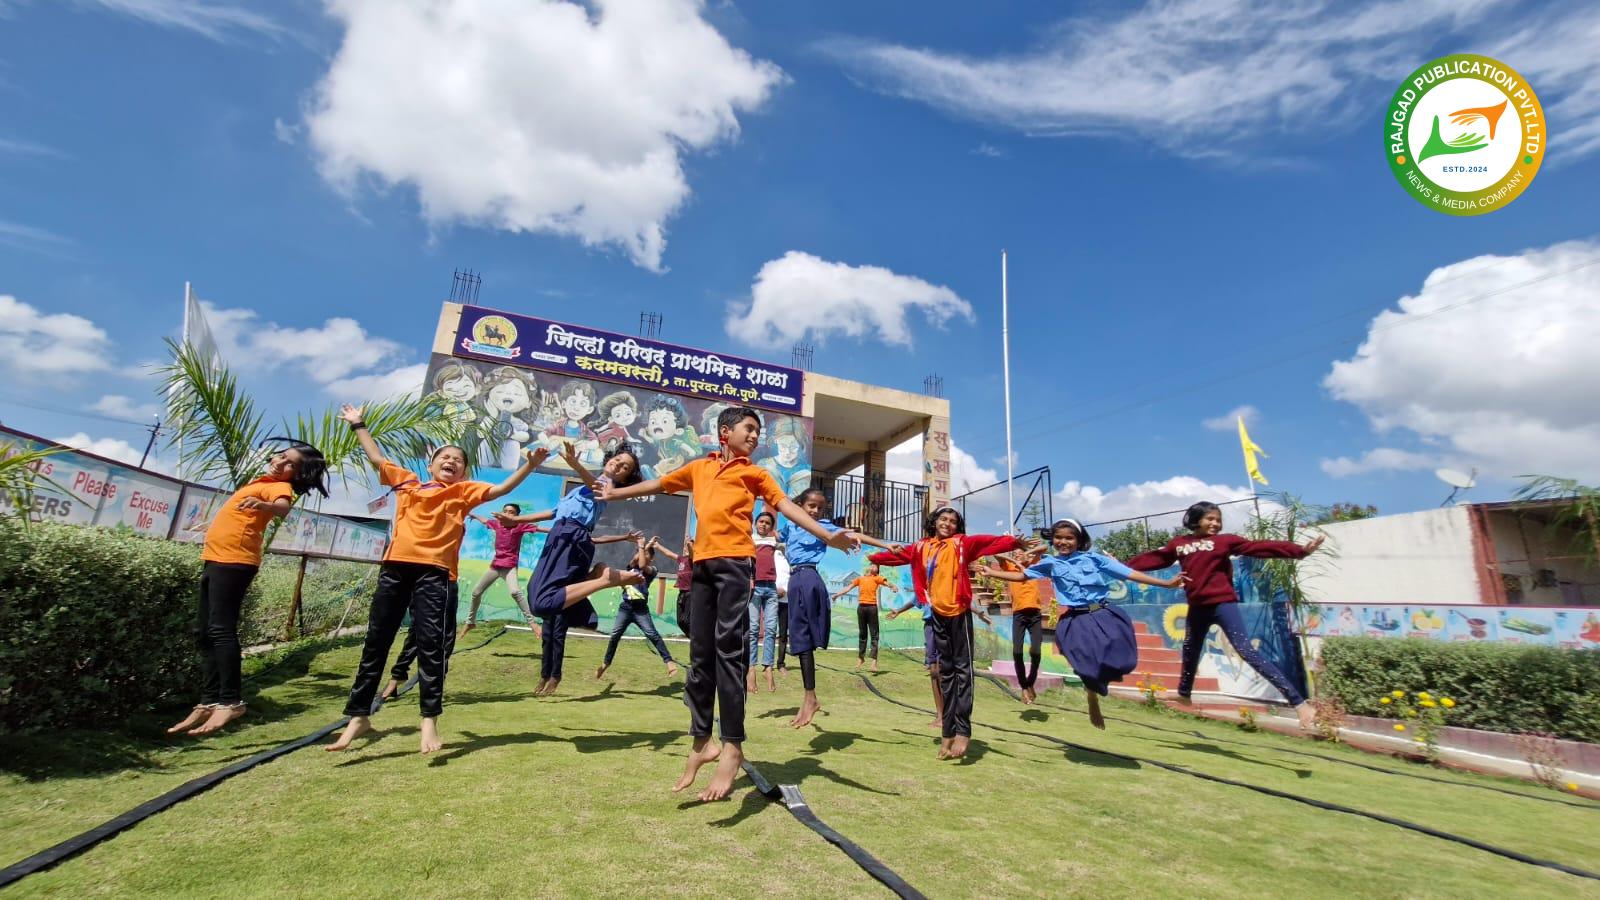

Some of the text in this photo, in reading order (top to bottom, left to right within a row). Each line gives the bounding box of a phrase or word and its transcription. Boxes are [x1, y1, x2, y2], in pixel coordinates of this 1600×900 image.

[545, 324, 606, 355] जिल्हा
[610, 339, 667, 367] परिषद
[670, 355, 742, 380] प्राथमिक
[746, 367, 788, 389] शाळा
[73, 471, 117, 499] Please
[129, 491, 169, 515] Excuse
[136, 511, 153, 529] Me
